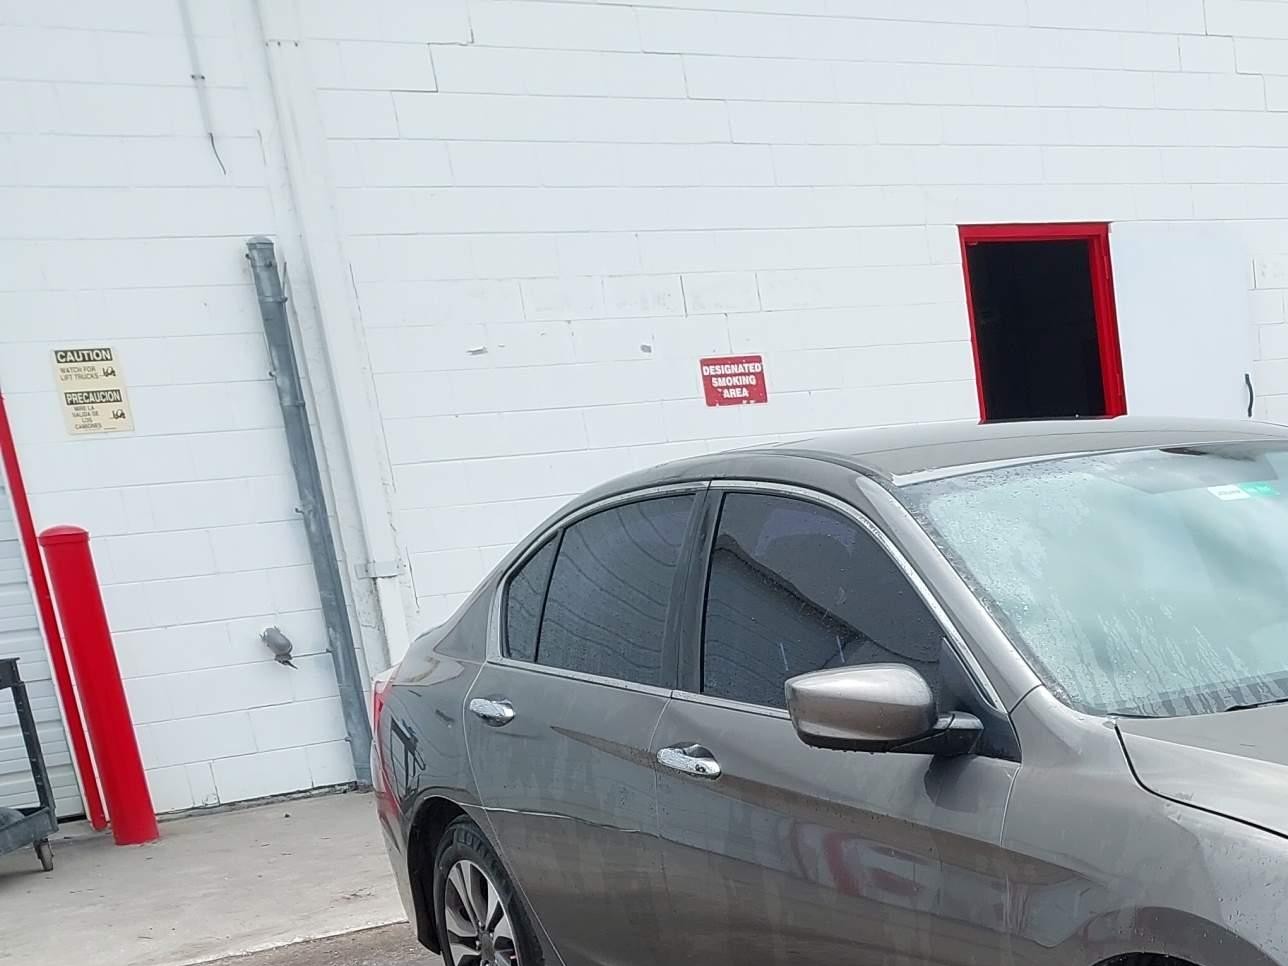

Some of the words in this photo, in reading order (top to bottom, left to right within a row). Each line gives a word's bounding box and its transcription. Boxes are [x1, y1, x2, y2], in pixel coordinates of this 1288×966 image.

[57, 350, 111, 362] CAUTION
[703, 363, 761, 375] DESIGNATED
[711, 375, 756, 387] SMOKING
[67, 391, 121, 404] PRECAUCION
[723, 387, 749, 398] AREA
